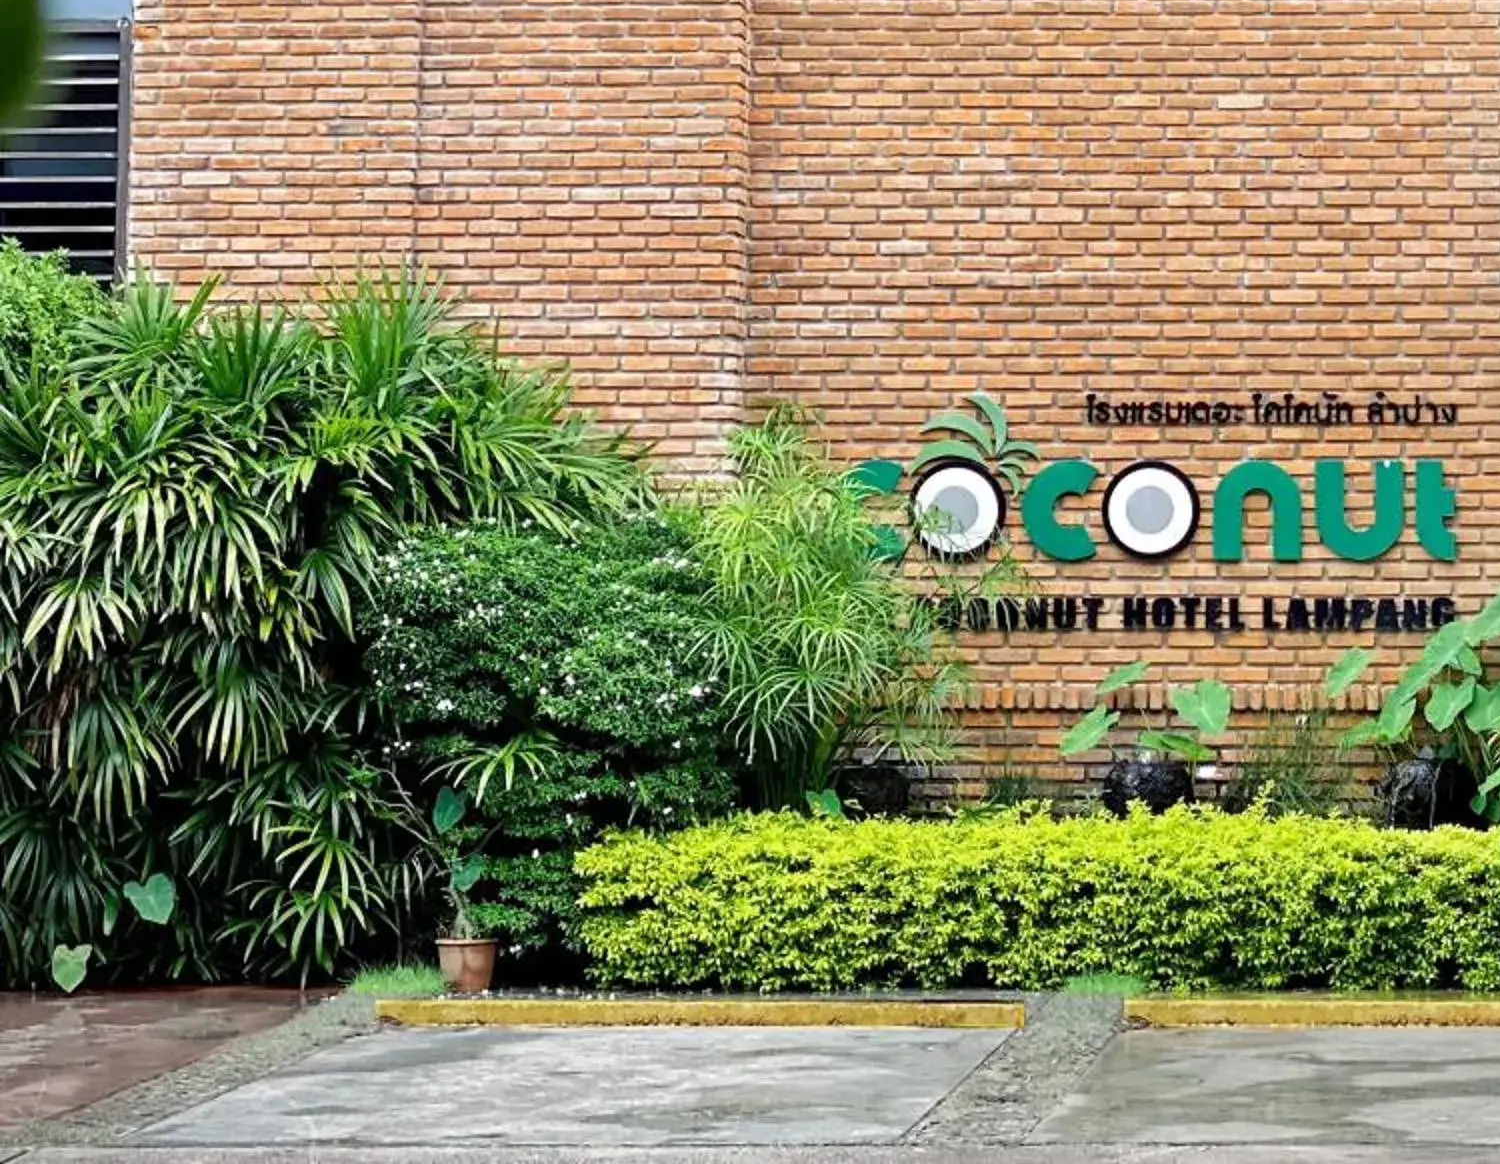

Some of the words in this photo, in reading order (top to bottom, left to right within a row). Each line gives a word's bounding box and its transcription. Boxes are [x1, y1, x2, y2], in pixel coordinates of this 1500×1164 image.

[1367, 390, 1457, 425] ลำปาง
[914, 596, 1104, 632] OCONUT
[1122, 596, 1245, 632] HOTEL
[1263, 596, 1456, 632] LAMPANG
